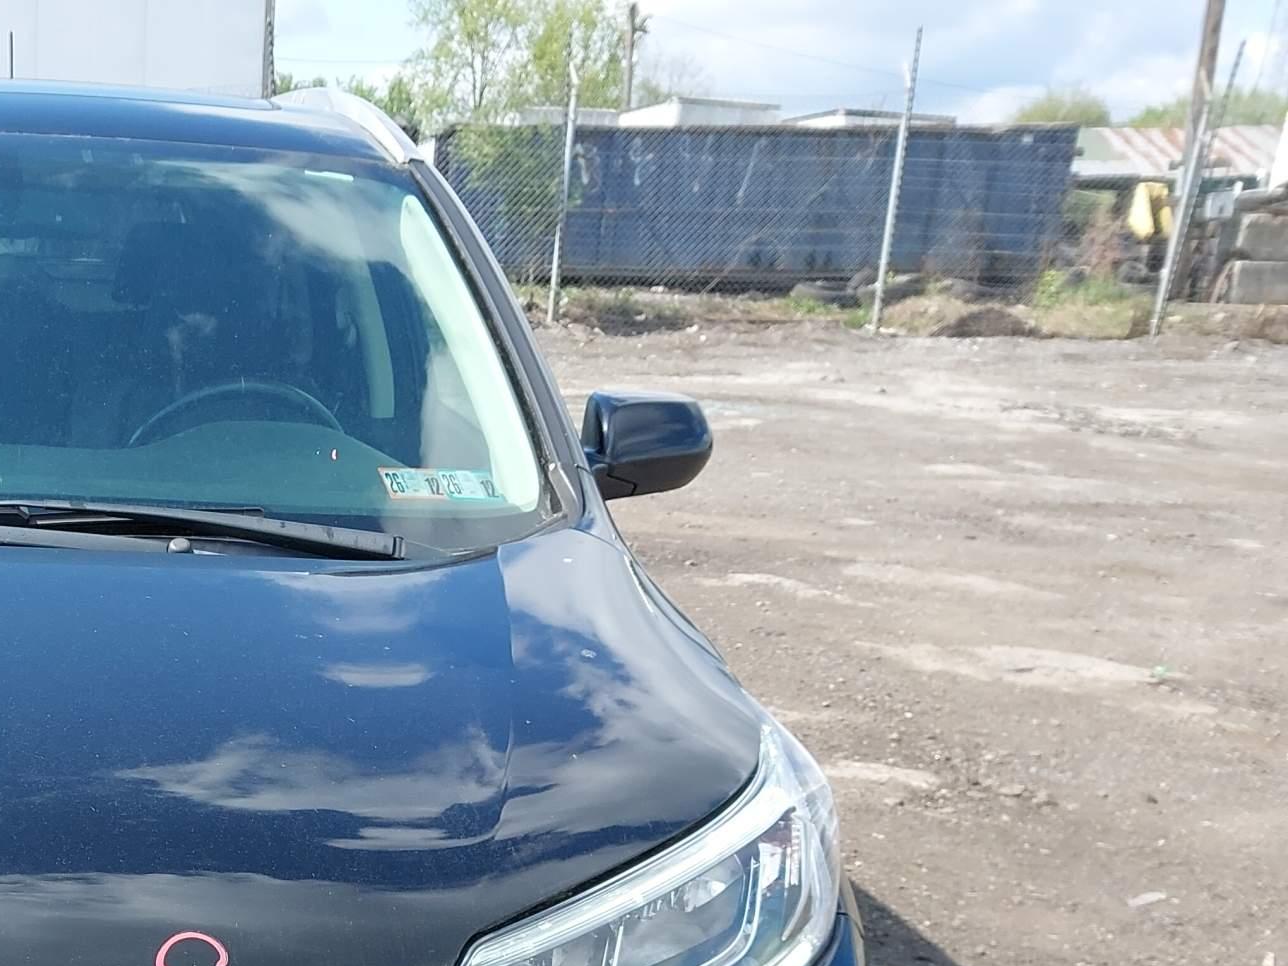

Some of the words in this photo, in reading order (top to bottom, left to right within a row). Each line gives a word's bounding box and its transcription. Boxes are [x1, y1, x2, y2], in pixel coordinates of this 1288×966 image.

[384, 472, 406, 494] 26
[424, 476, 444, 496] 12
[441, 473, 462, 495] 26
[479, 479, 500, 499] 12
